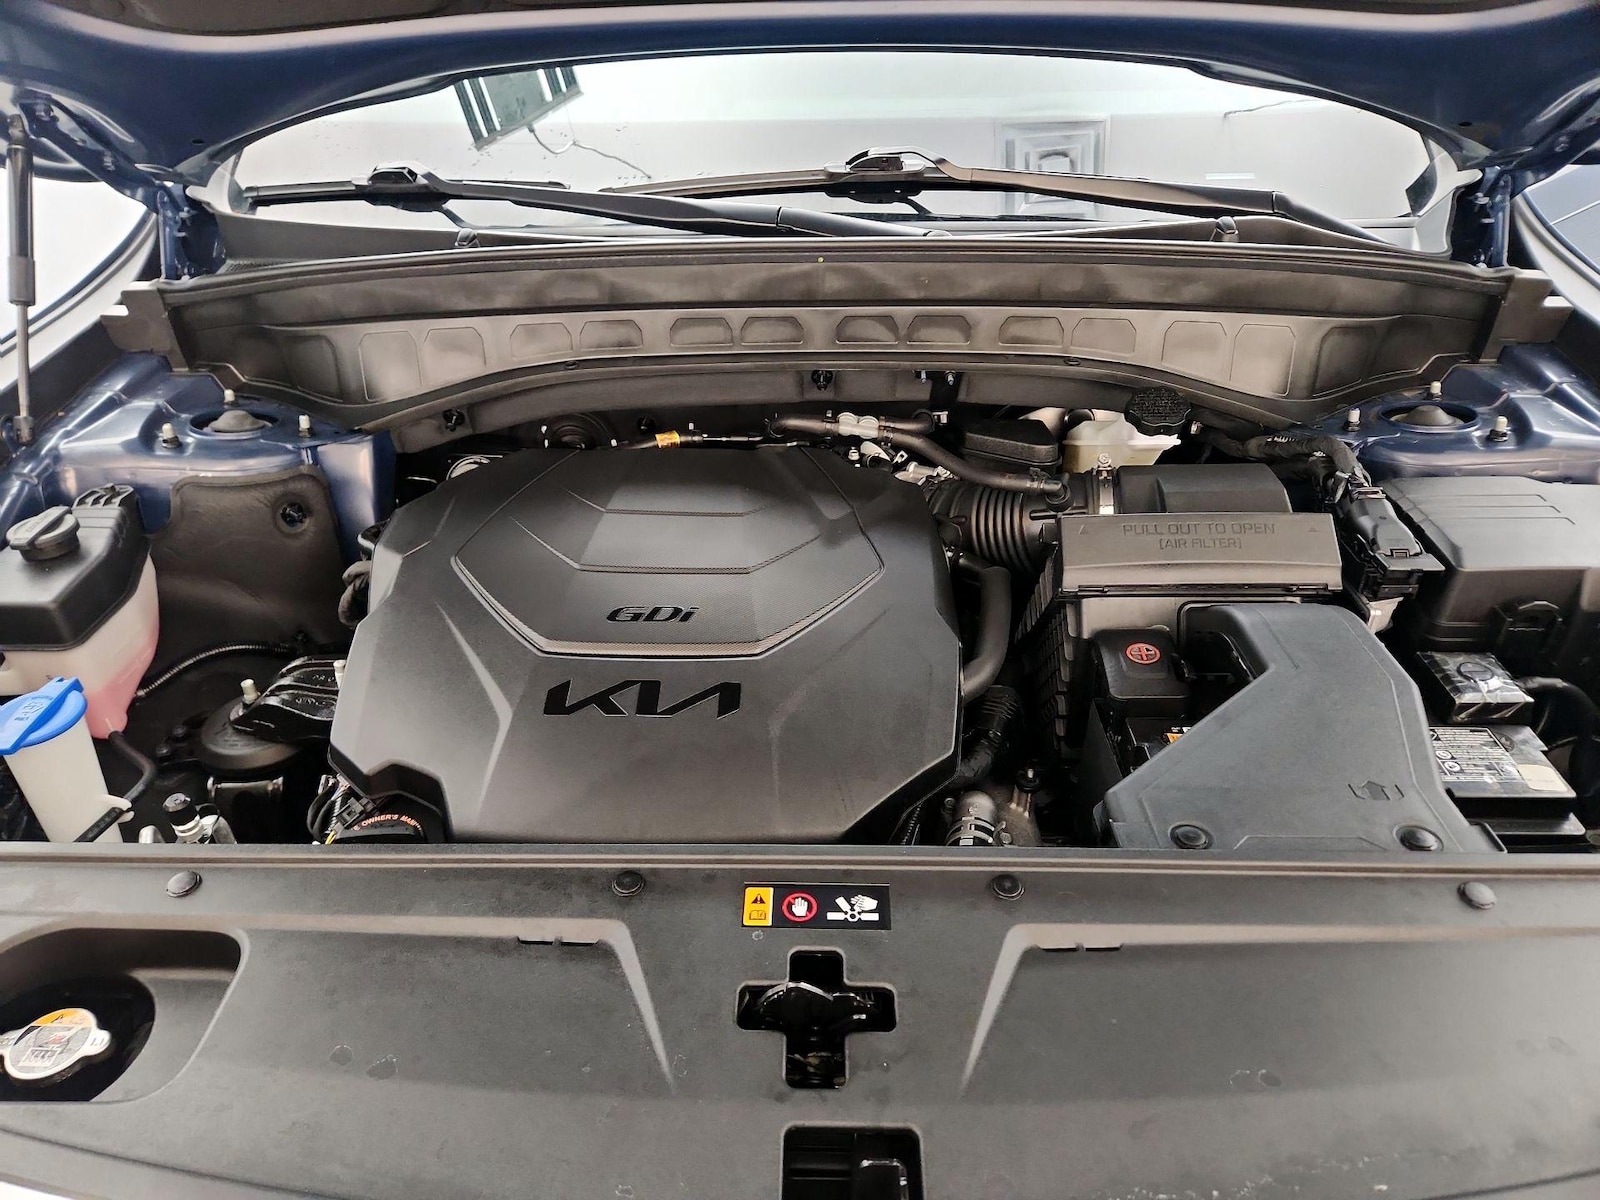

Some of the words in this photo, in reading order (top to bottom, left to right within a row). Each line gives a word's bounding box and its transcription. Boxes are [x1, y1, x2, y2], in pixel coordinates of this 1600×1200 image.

[1122, 522, 1164, 536] PULL
[1168, 522, 1200, 535] OUT
[1205, 522, 1227, 535] TO
[1231, 522, 1275, 535] OPEN
[606, 605, 700, 623] GDi
[543, 679, 742, 719] KIA
[361, 814, 399, 827] OWNER'S
